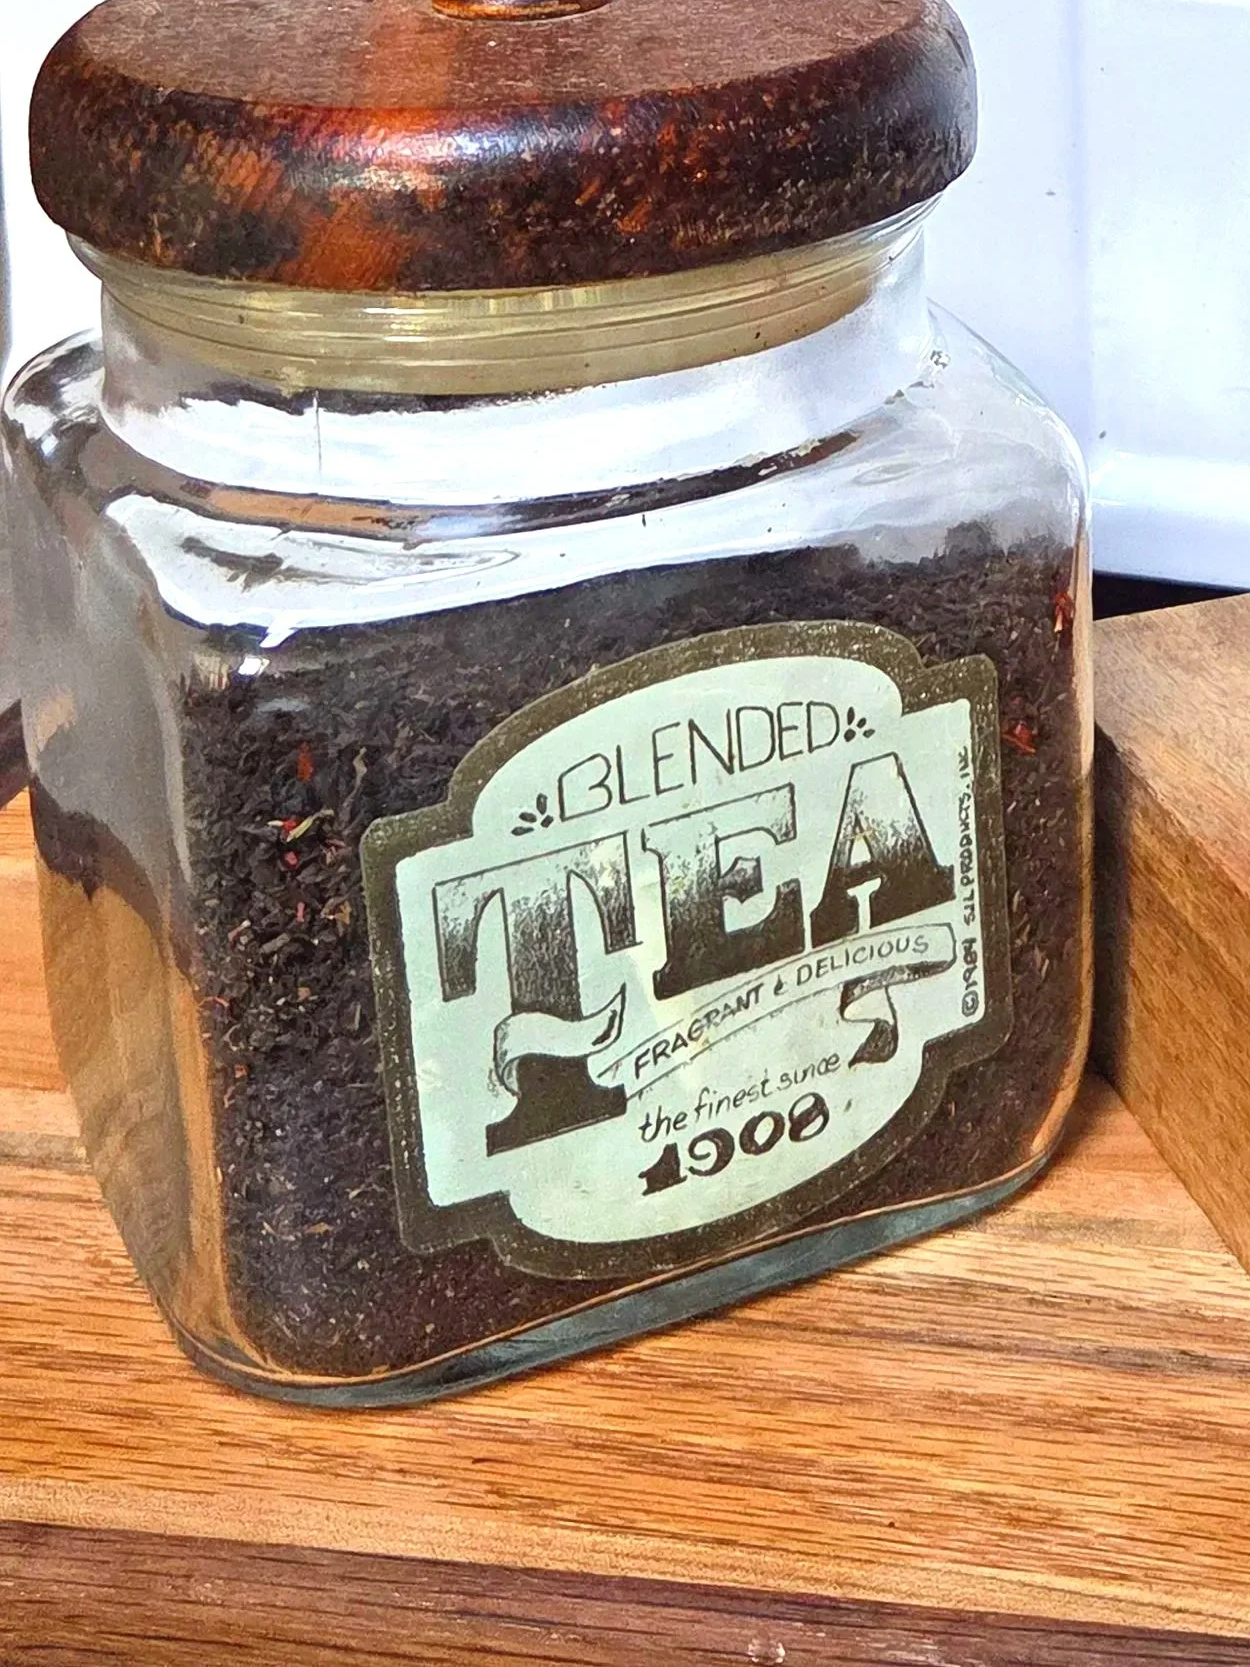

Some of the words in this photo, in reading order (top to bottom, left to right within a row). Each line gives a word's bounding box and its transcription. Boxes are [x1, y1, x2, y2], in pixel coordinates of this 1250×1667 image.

[557, 701, 839, 821] BLENDED
[432, 751, 956, 1157] TEA
[634, 984, 763, 1079] FRAGRANT
[796, 934, 930, 985] DELICIOUS
[638, 1105, 687, 1143] the
[694, 1067, 772, 1123] finest
[777, 1052, 841, 1092] since
[638, 1092, 829, 1196] 1908
